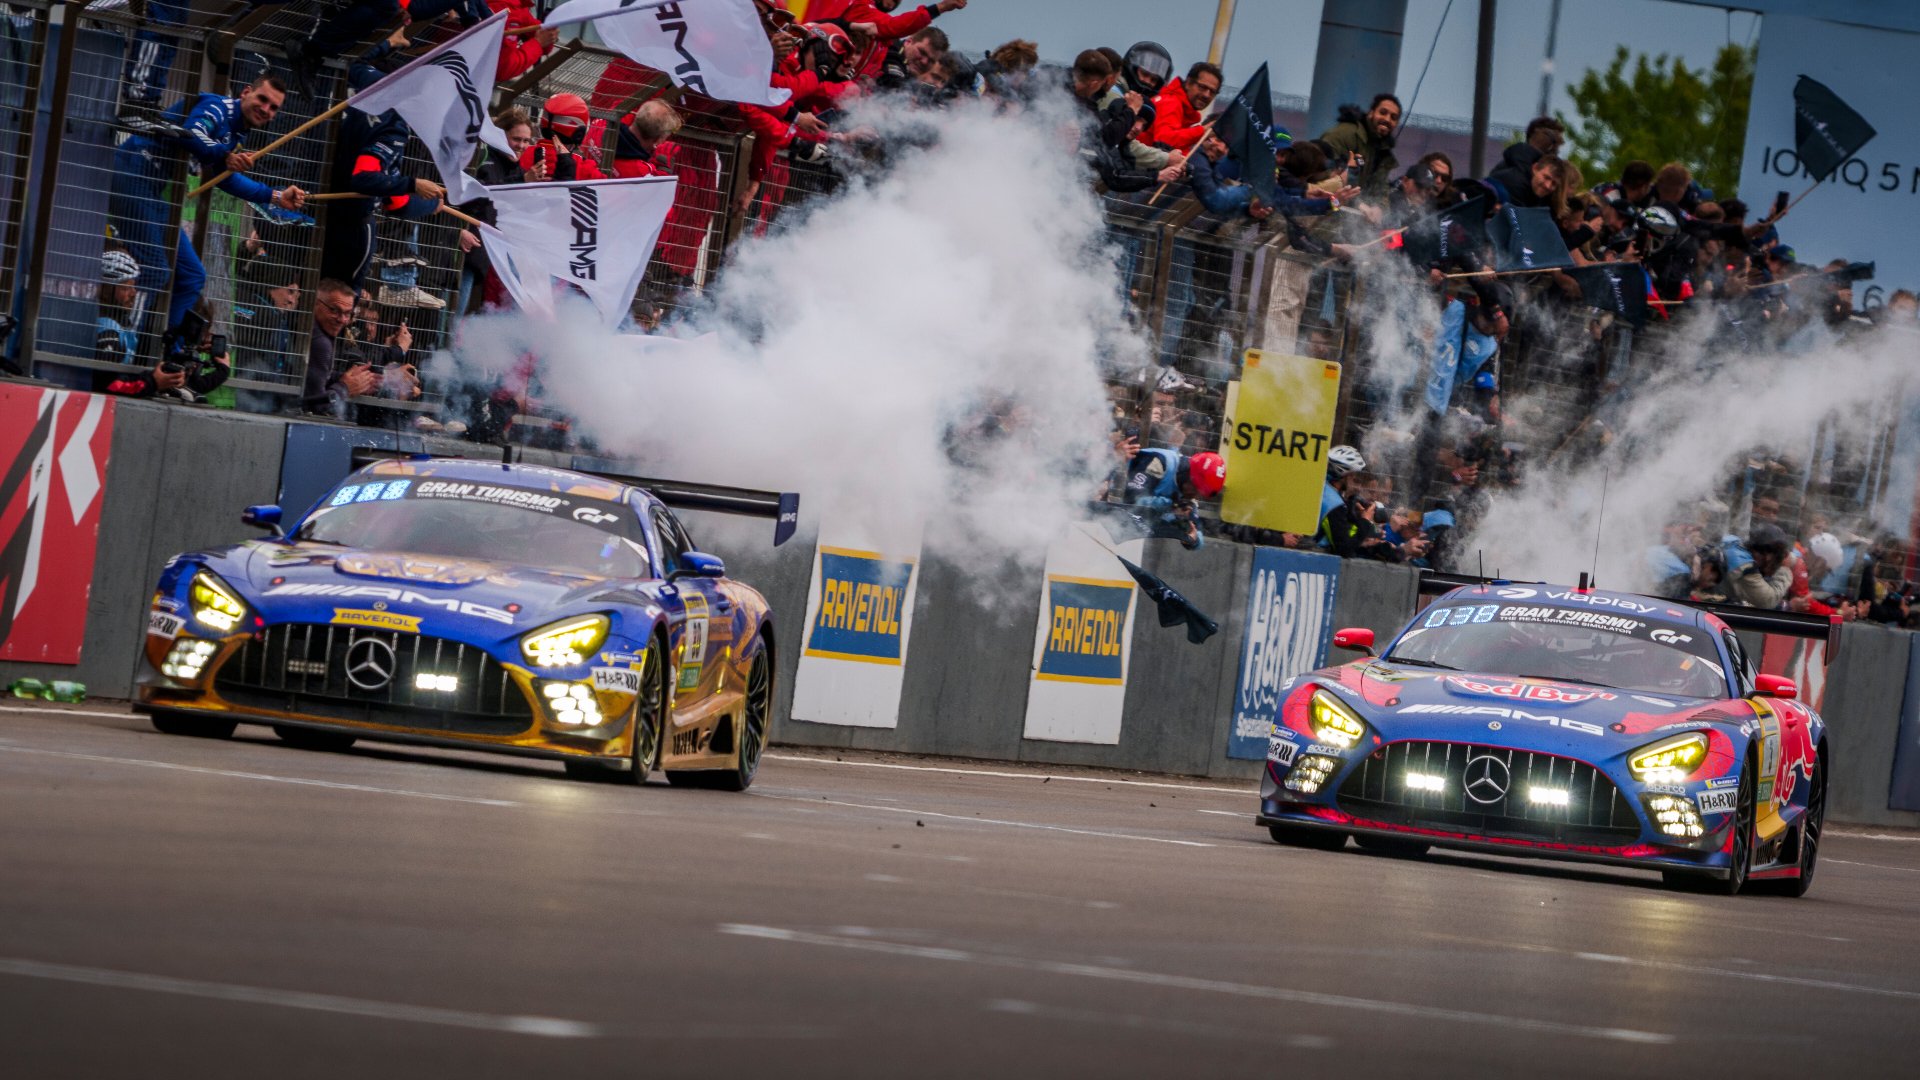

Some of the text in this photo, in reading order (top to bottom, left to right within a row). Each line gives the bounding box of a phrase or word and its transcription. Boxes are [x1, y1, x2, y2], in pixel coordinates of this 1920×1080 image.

[1762, 146, 1866, 193] IOQ
[1879, 162, 1900, 191] 5
[569, 217, 598, 281] AMG
[1235, 422, 1328, 462] START
[417, 481, 475, 496] GRAN
[345, 583, 515, 624] AMG
[821, 578, 902, 635] RAVENOL
[1500, 606, 1549, 619] GRAN
[1546, 590, 1658, 614] viaplay
[340, 611, 412, 628] RAVENOL
[1424, 605, 1500, 628] 038
[1582, 621, 1632, 635] SIMULATOR
[1050, 605, 1122, 656] RAVENOL
[596, 671, 624, 686] H&R
[1434, 675, 1619, 703] Red Bull
[1466, 706, 1604, 736] AMG
[1648, 785, 1686, 795] sparco
[1701, 793, 1726, 809] H&R
